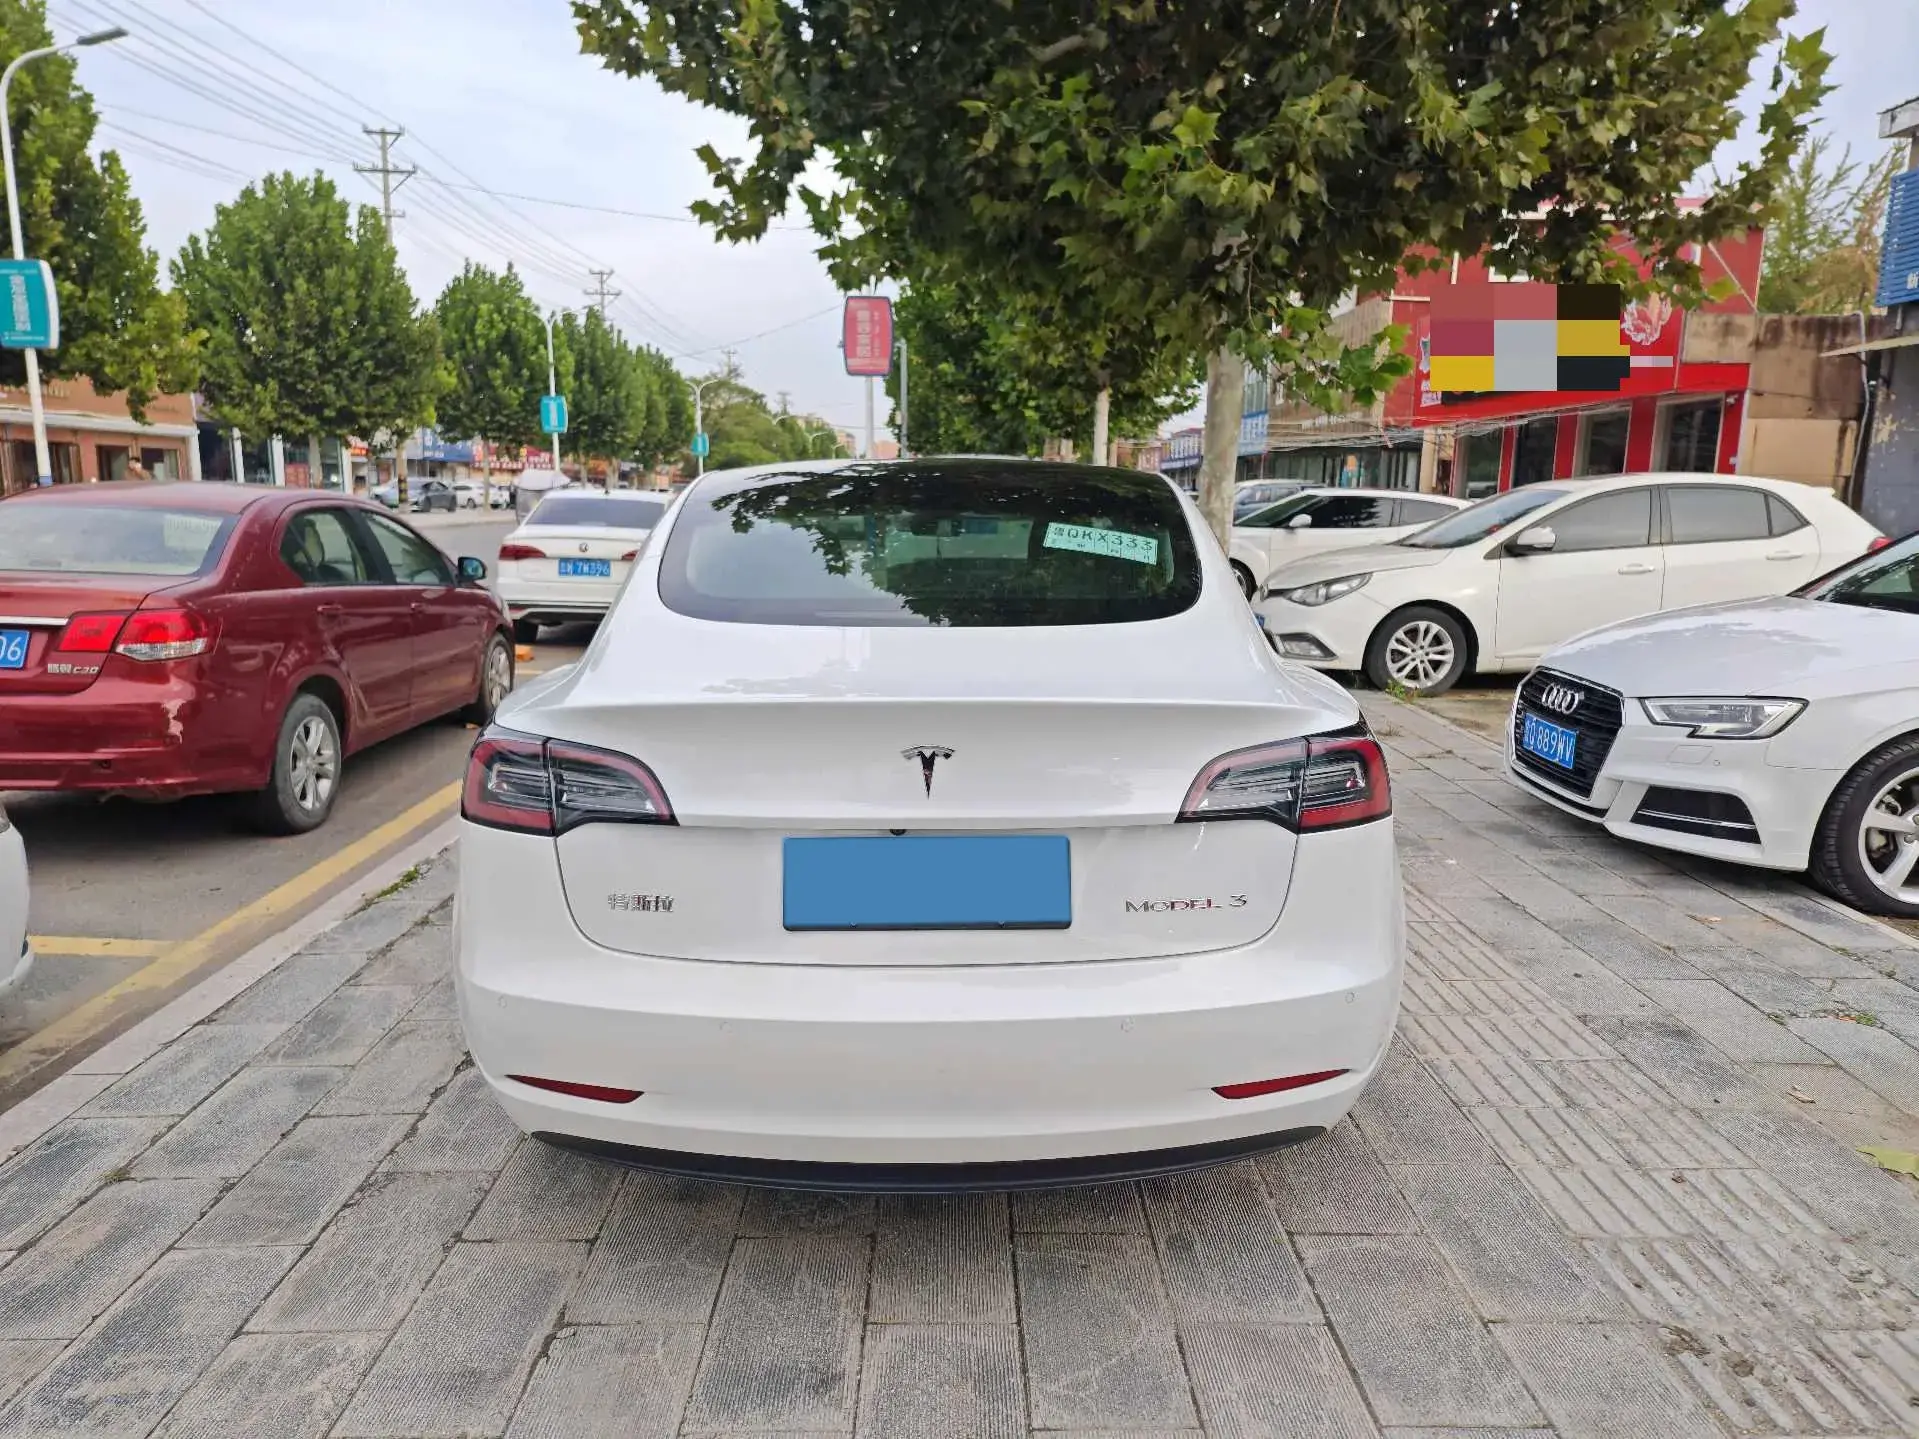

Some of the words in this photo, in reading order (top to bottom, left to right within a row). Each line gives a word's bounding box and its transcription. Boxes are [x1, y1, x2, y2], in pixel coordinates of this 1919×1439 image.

[607, 894, 675, 912] 特斯拉
[1125, 898, 1224, 913] MODEL
[1228, 894, 1247, 908] 3
